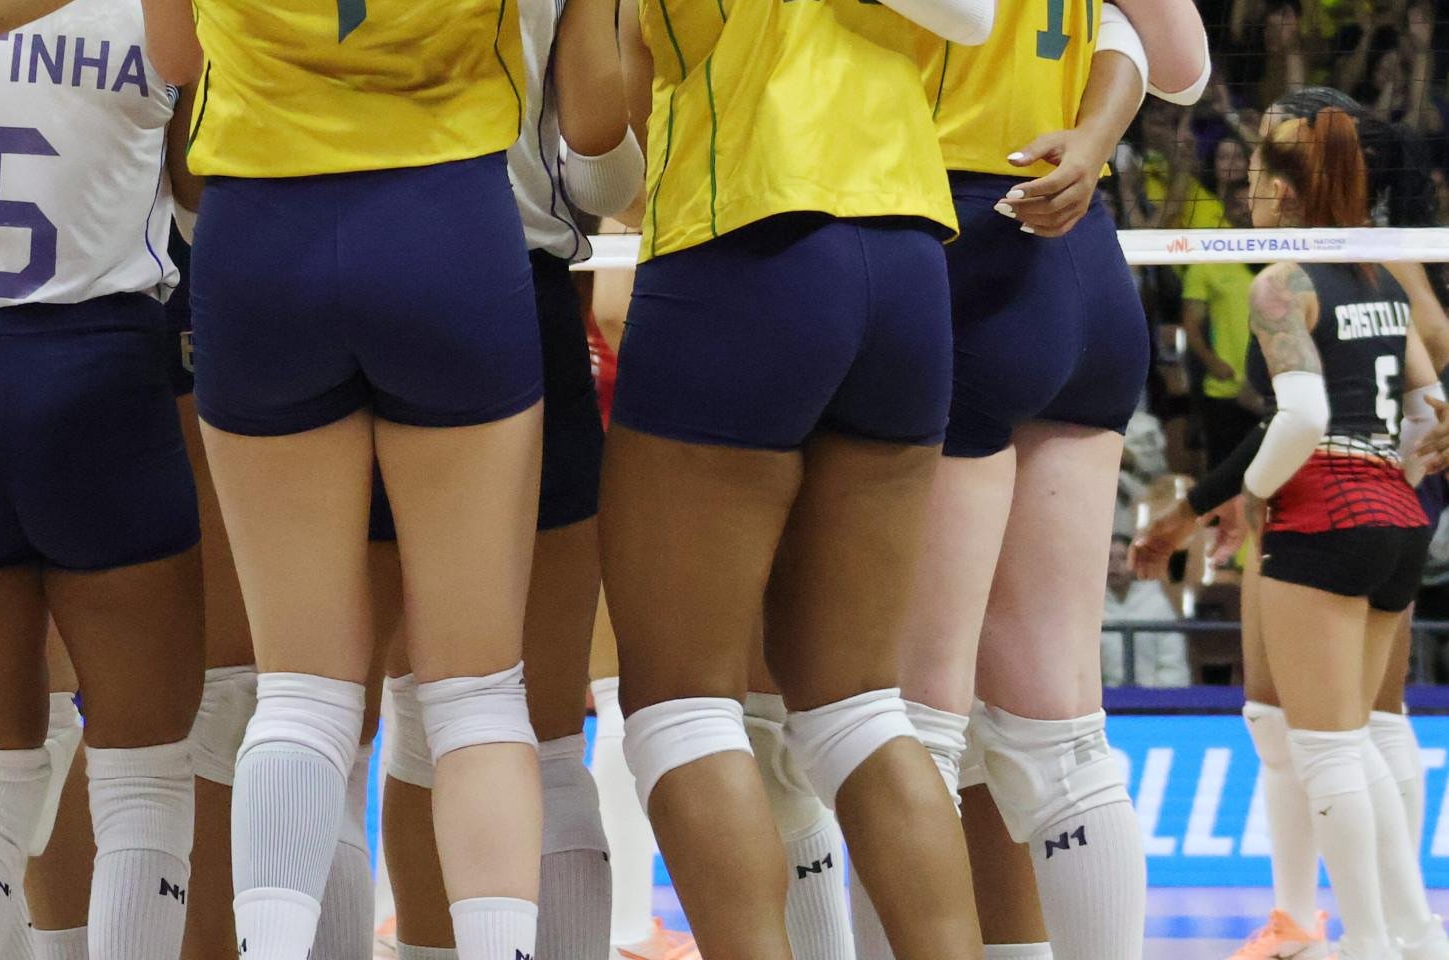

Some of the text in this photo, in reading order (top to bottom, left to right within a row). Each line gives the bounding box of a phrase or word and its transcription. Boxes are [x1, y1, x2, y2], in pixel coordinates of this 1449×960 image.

[1201, 238, 1310, 252] VOLLEYBALL
[1335, 301, 1410, 340] CASTILL
[1046, 825, 1088, 859] N1
[796, 853, 834, 879] N1
[159, 877, 185, 905] N1
